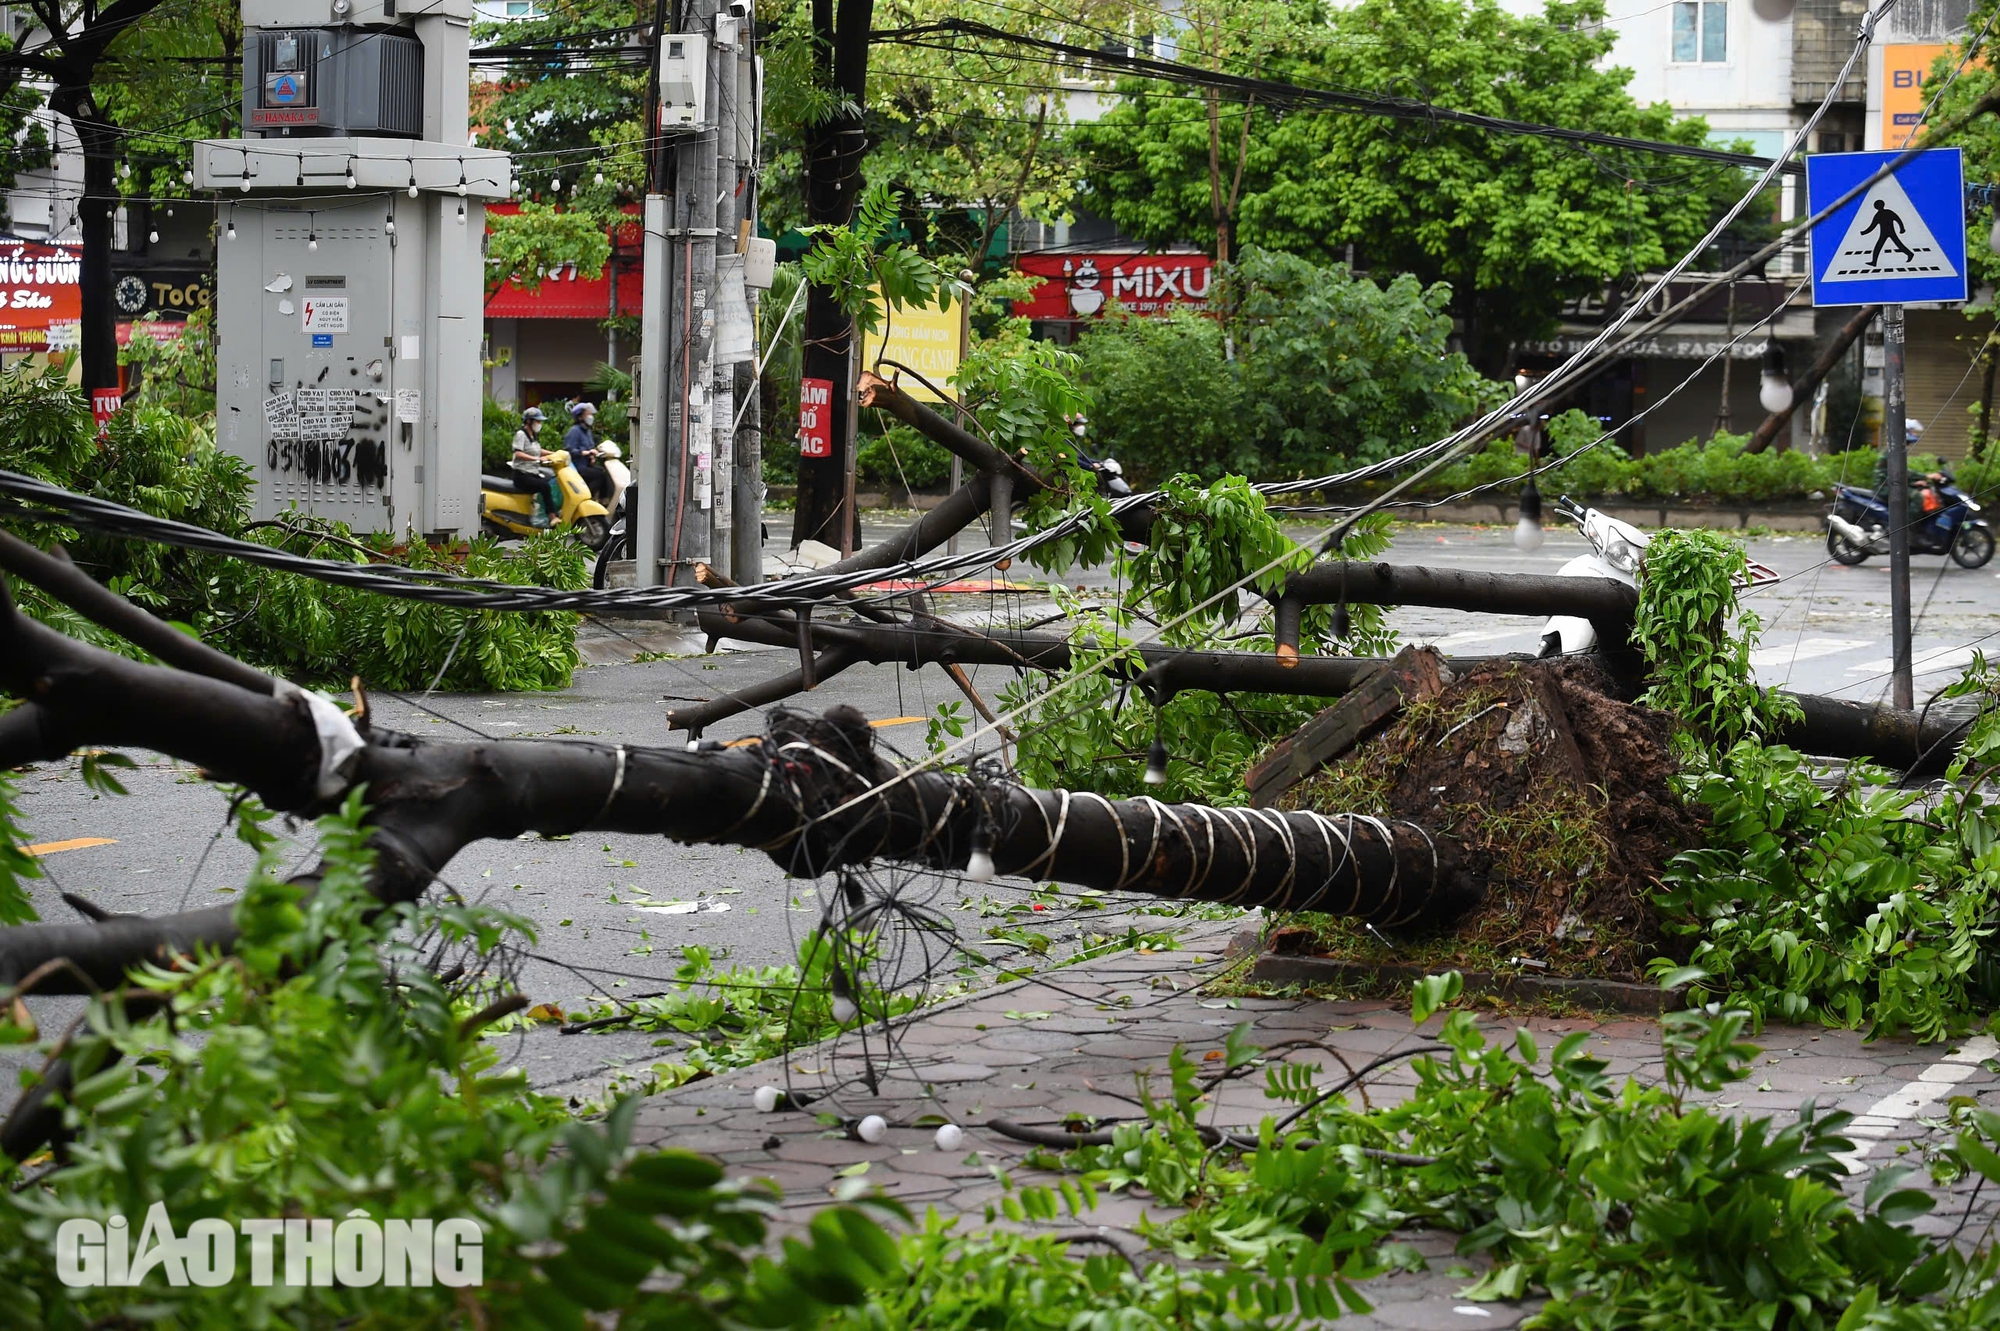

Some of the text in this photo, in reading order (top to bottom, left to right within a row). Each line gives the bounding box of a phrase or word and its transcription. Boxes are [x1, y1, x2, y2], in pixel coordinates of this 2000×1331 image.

[264, 112, 305, 123] HANAKA
[1140, 302, 1158, 311] 1997
[265, 399, 277, 408] CHO
[276, 393, 289, 402] VAY
